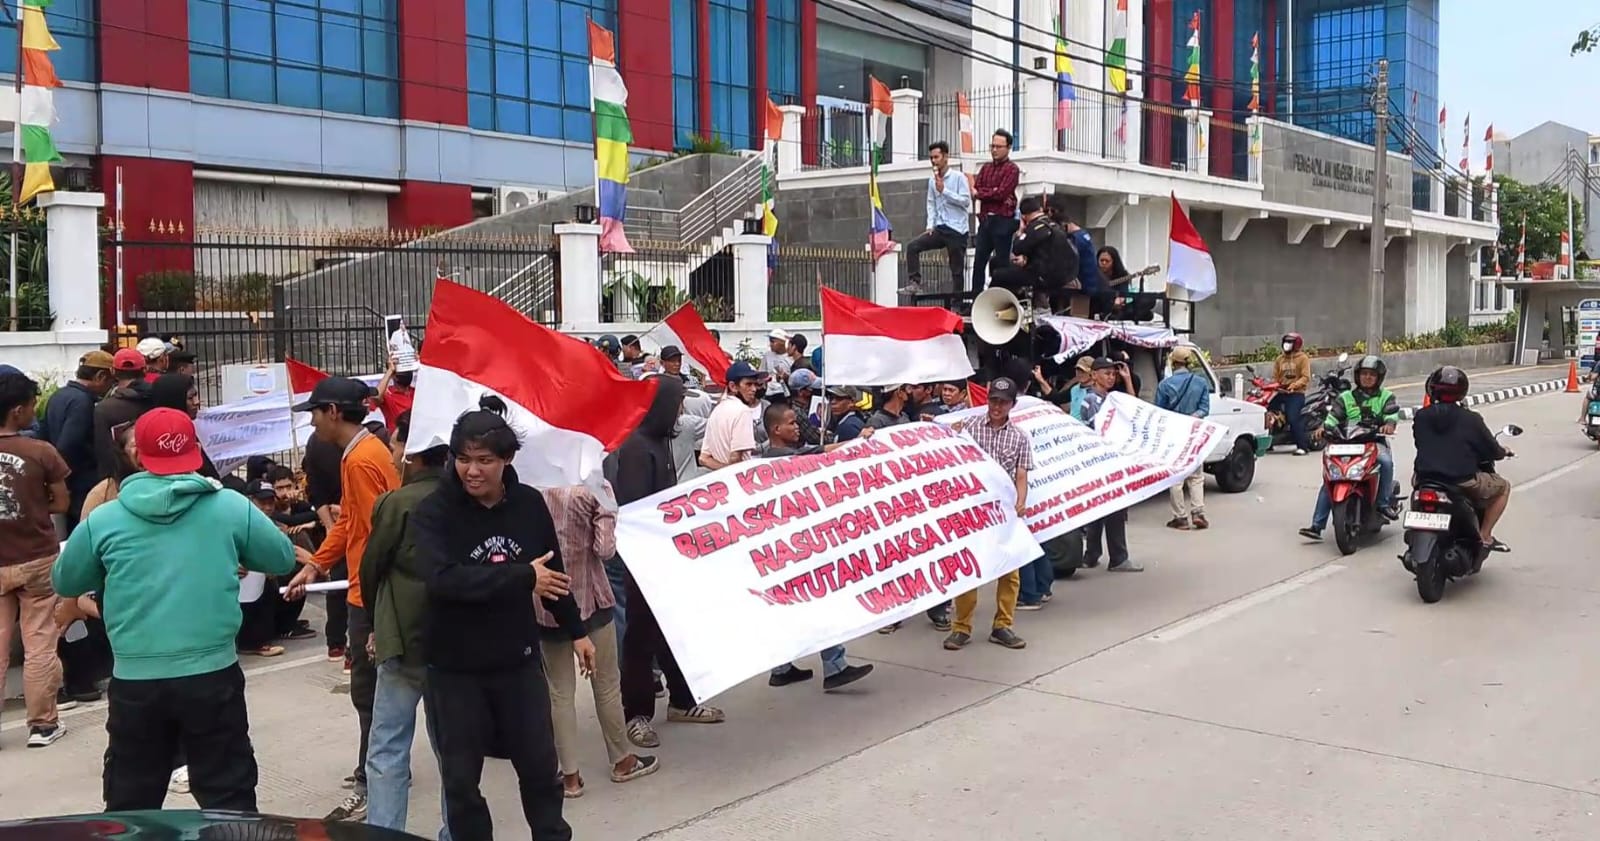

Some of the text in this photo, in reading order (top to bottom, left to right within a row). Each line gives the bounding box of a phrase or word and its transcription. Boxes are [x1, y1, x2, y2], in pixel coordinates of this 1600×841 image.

[1028, 464, 1082, 490] khususnya
[657, 481, 729, 524] STOP
[672, 486, 821, 560] BEBASKAN
[815, 463, 895, 508] BAPAK
[886, 446, 962, 483] RAZMAN
[749, 472, 988, 578] NASUTION DARI SEGALA
[470, 544, 484, 560] THE
[507, 538, 522, 555] FACE
[874, 523, 945, 572] JAKSA
[856, 547, 982, 614] UMUM (JPU)
